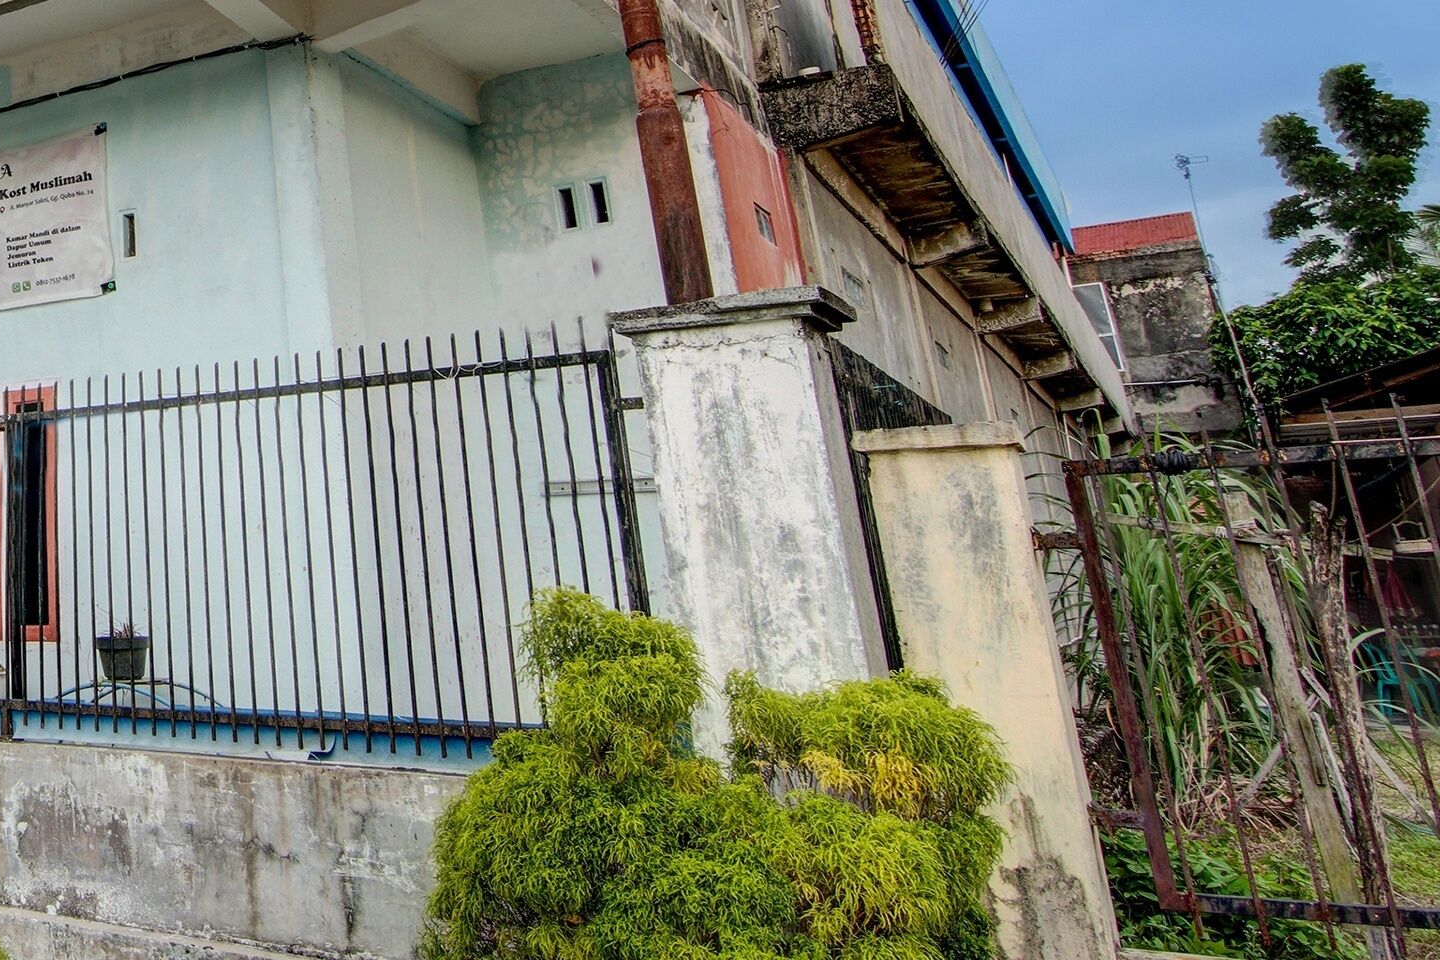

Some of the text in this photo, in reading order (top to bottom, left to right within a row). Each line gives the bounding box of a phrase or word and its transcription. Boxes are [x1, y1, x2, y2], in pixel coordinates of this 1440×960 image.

[0, 186, 27, 200] Kost
[30, 171, 93, 193] Muslimah
[60, 192, 75, 200] Quba
[6, 235, 28, 243] Kamar
[29, 230, 50, 239] Mandi
[60, 225, 81, 233] dalam
[7, 239, 52, 251] Dapur Umum
[7, 251, 37, 260] Jemuran
[8, 256, 54, 268] Listrik Token
